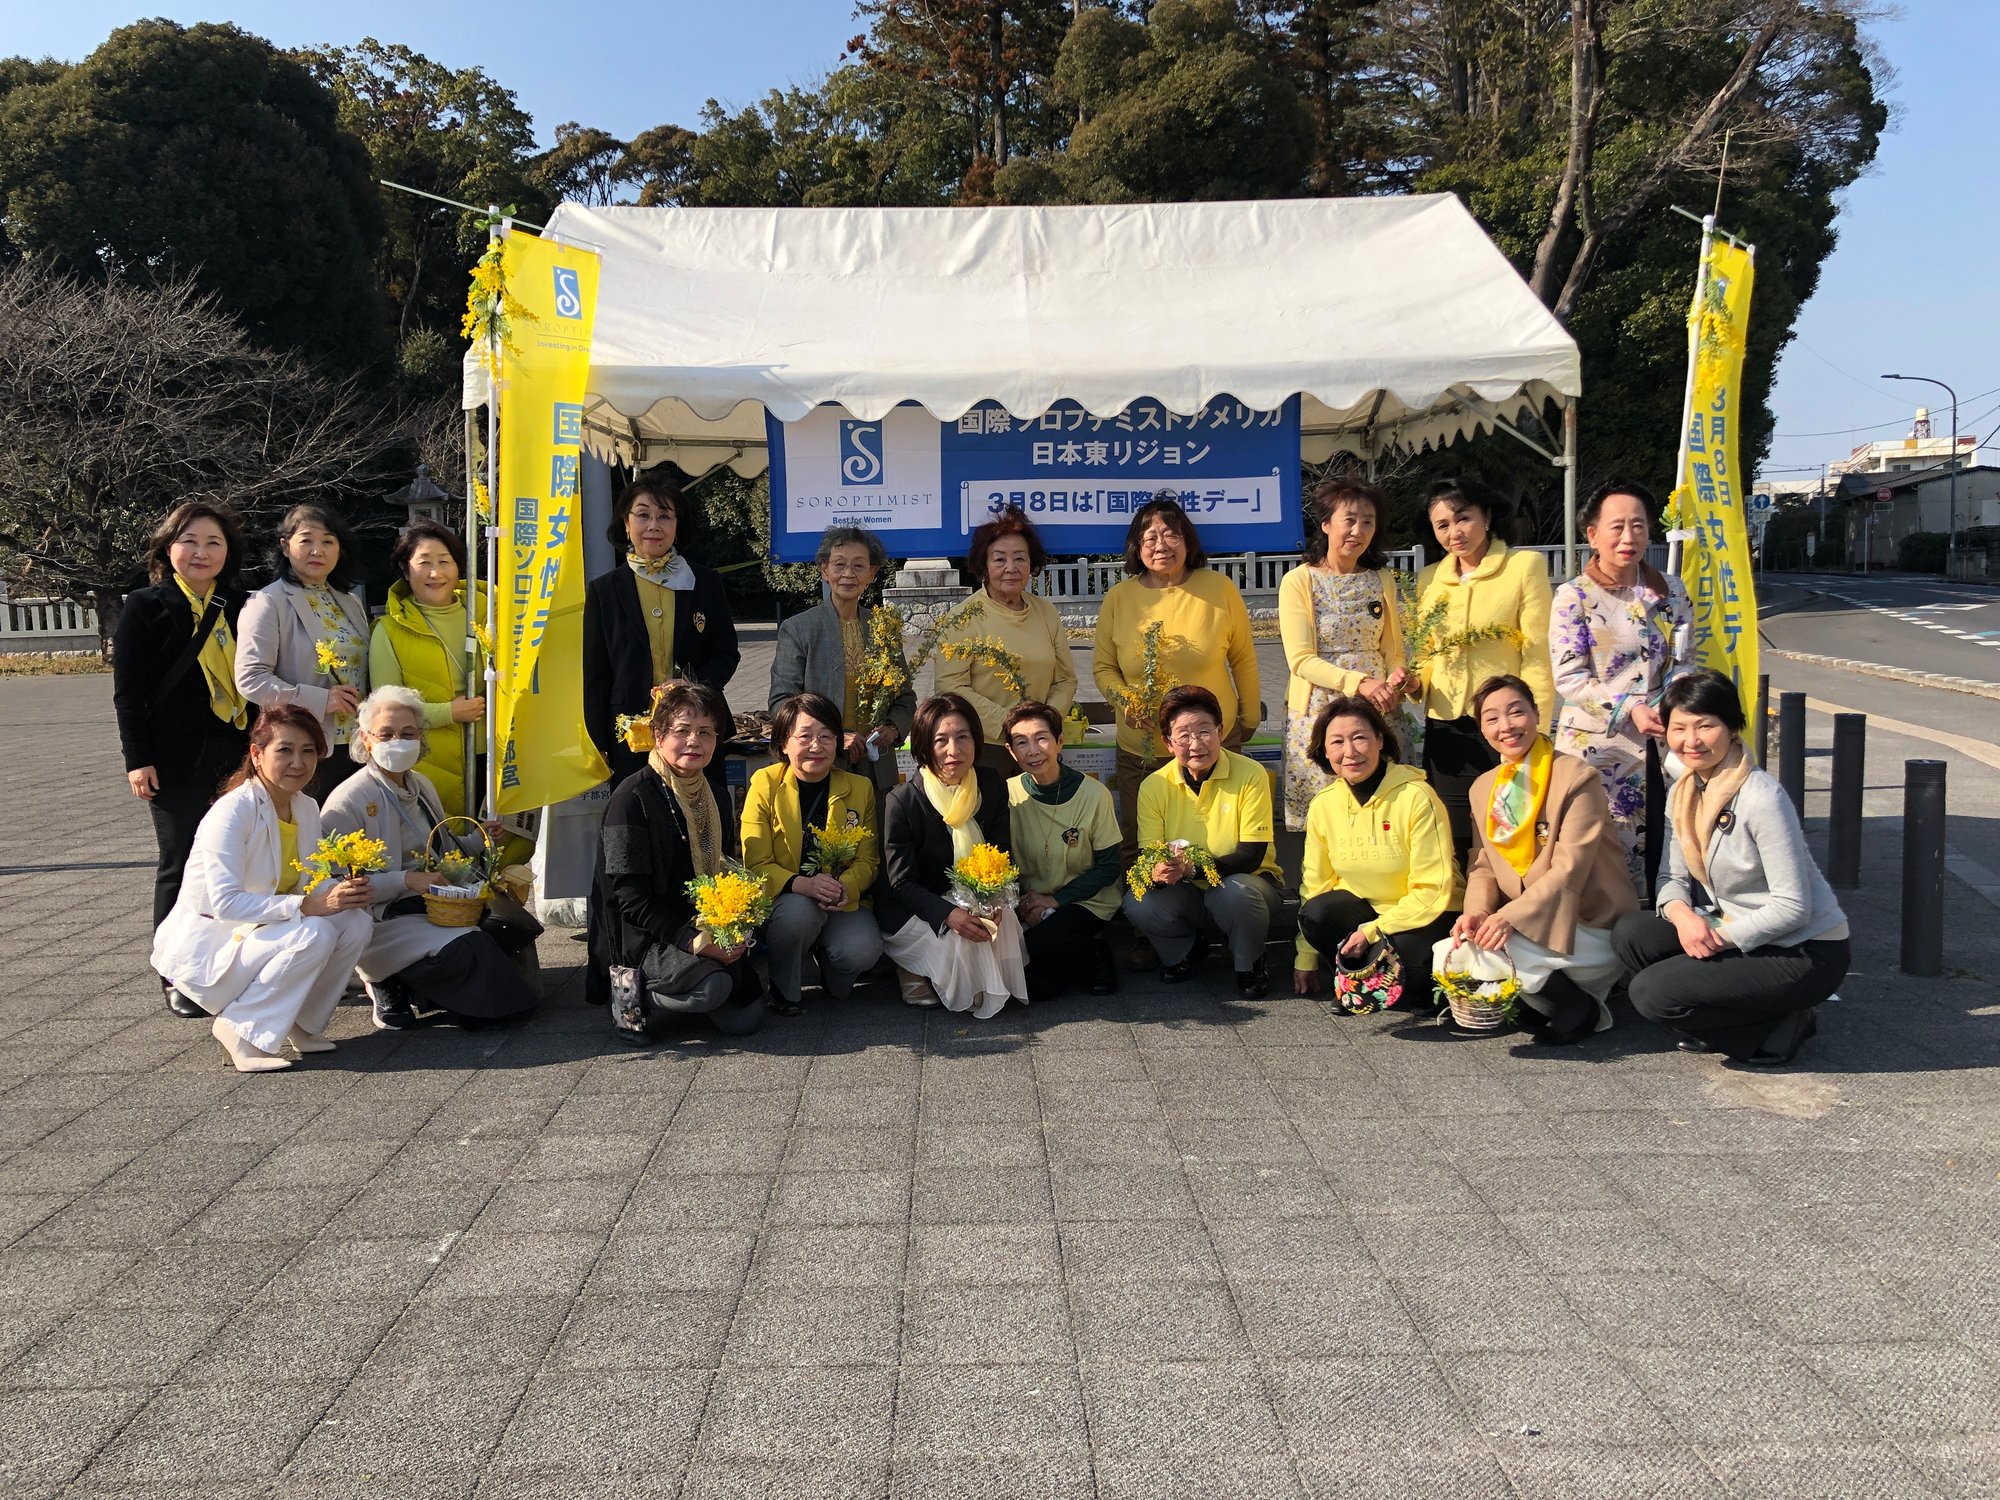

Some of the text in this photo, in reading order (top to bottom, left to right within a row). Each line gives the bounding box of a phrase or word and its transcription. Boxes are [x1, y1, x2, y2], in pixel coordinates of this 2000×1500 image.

[537, 340, 571, 352] Investing
[1032, 439, 1211, 467] 日本東リジョン
[1710, 386, 1733, 508] 3月8日
[796, 493, 933, 509] SOROPTIMIST
[832, 516, 892, 525] Best for Women
[1688, 412, 1743, 689] 国際女性デー
